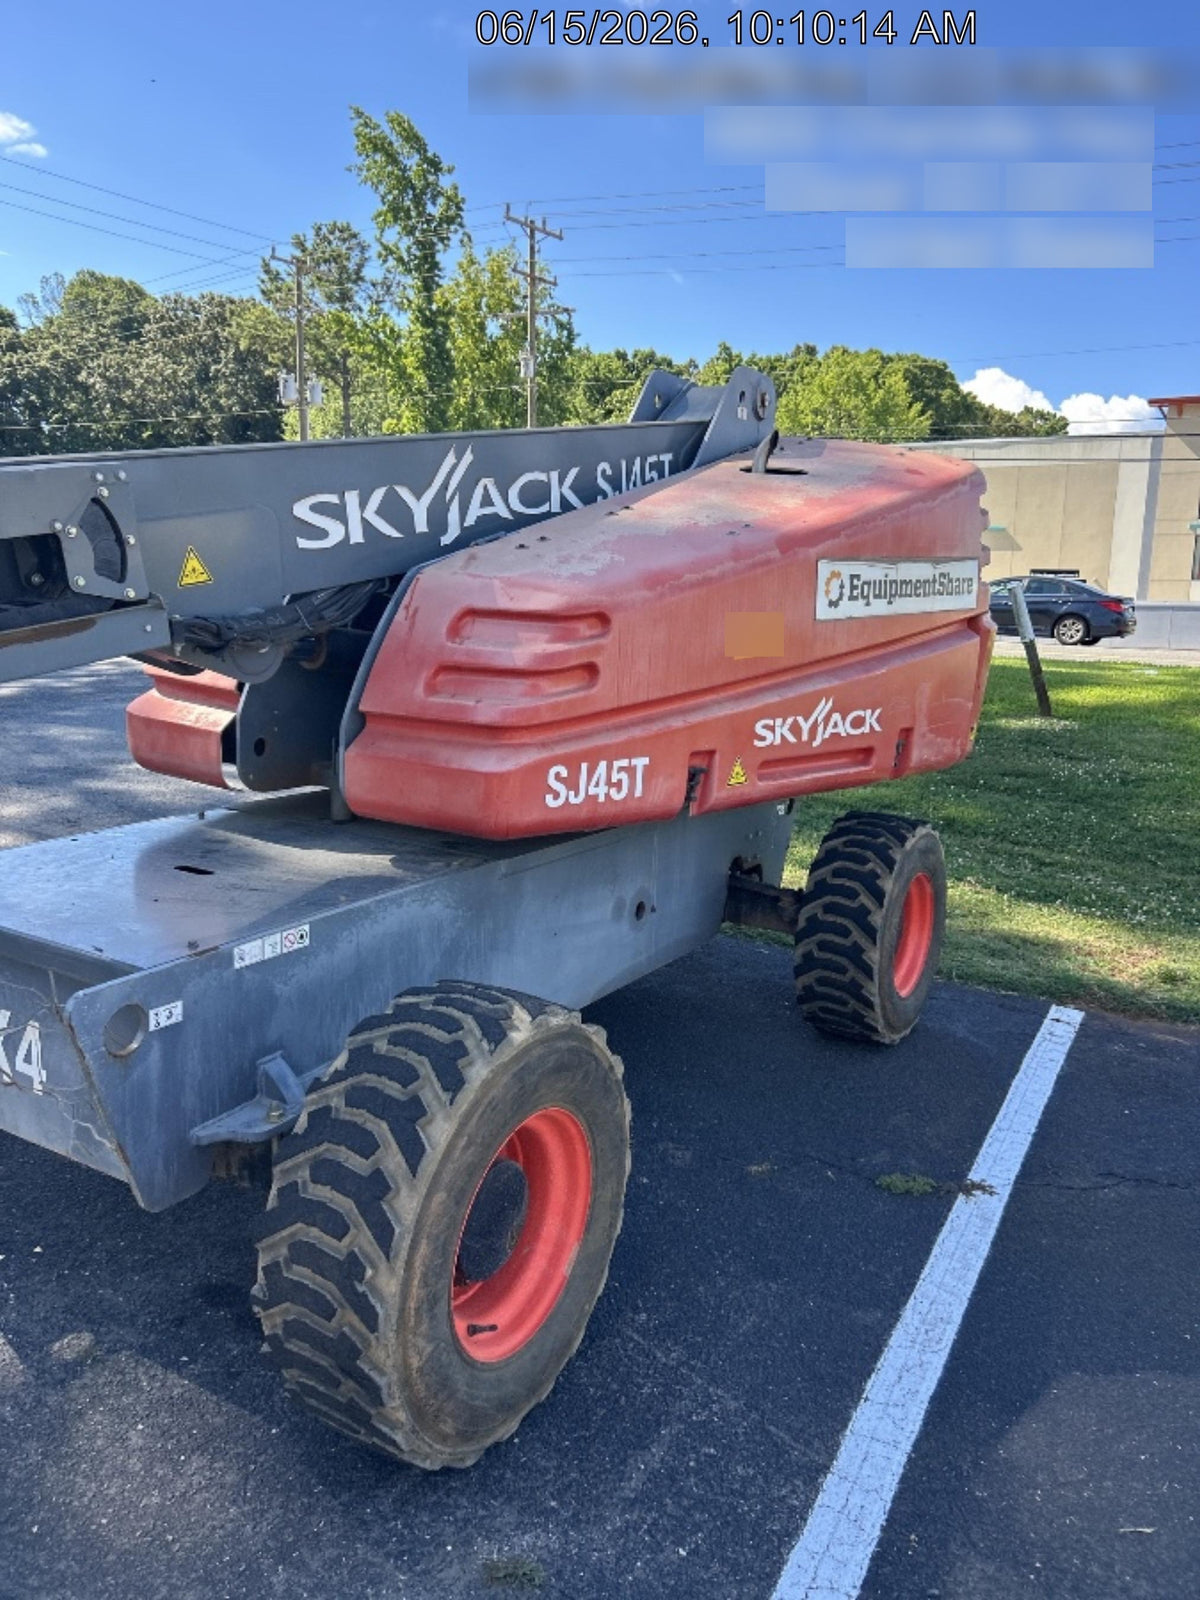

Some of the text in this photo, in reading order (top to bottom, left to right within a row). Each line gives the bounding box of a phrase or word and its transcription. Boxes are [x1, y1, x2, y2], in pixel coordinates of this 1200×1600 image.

[292, 443, 585, 550] SKYJACK
[847, 571, 974, 607] EquipmentShare
[753, 696, 883, 748] SKYJACK
[545, 757, 649, 808] SJ45T
